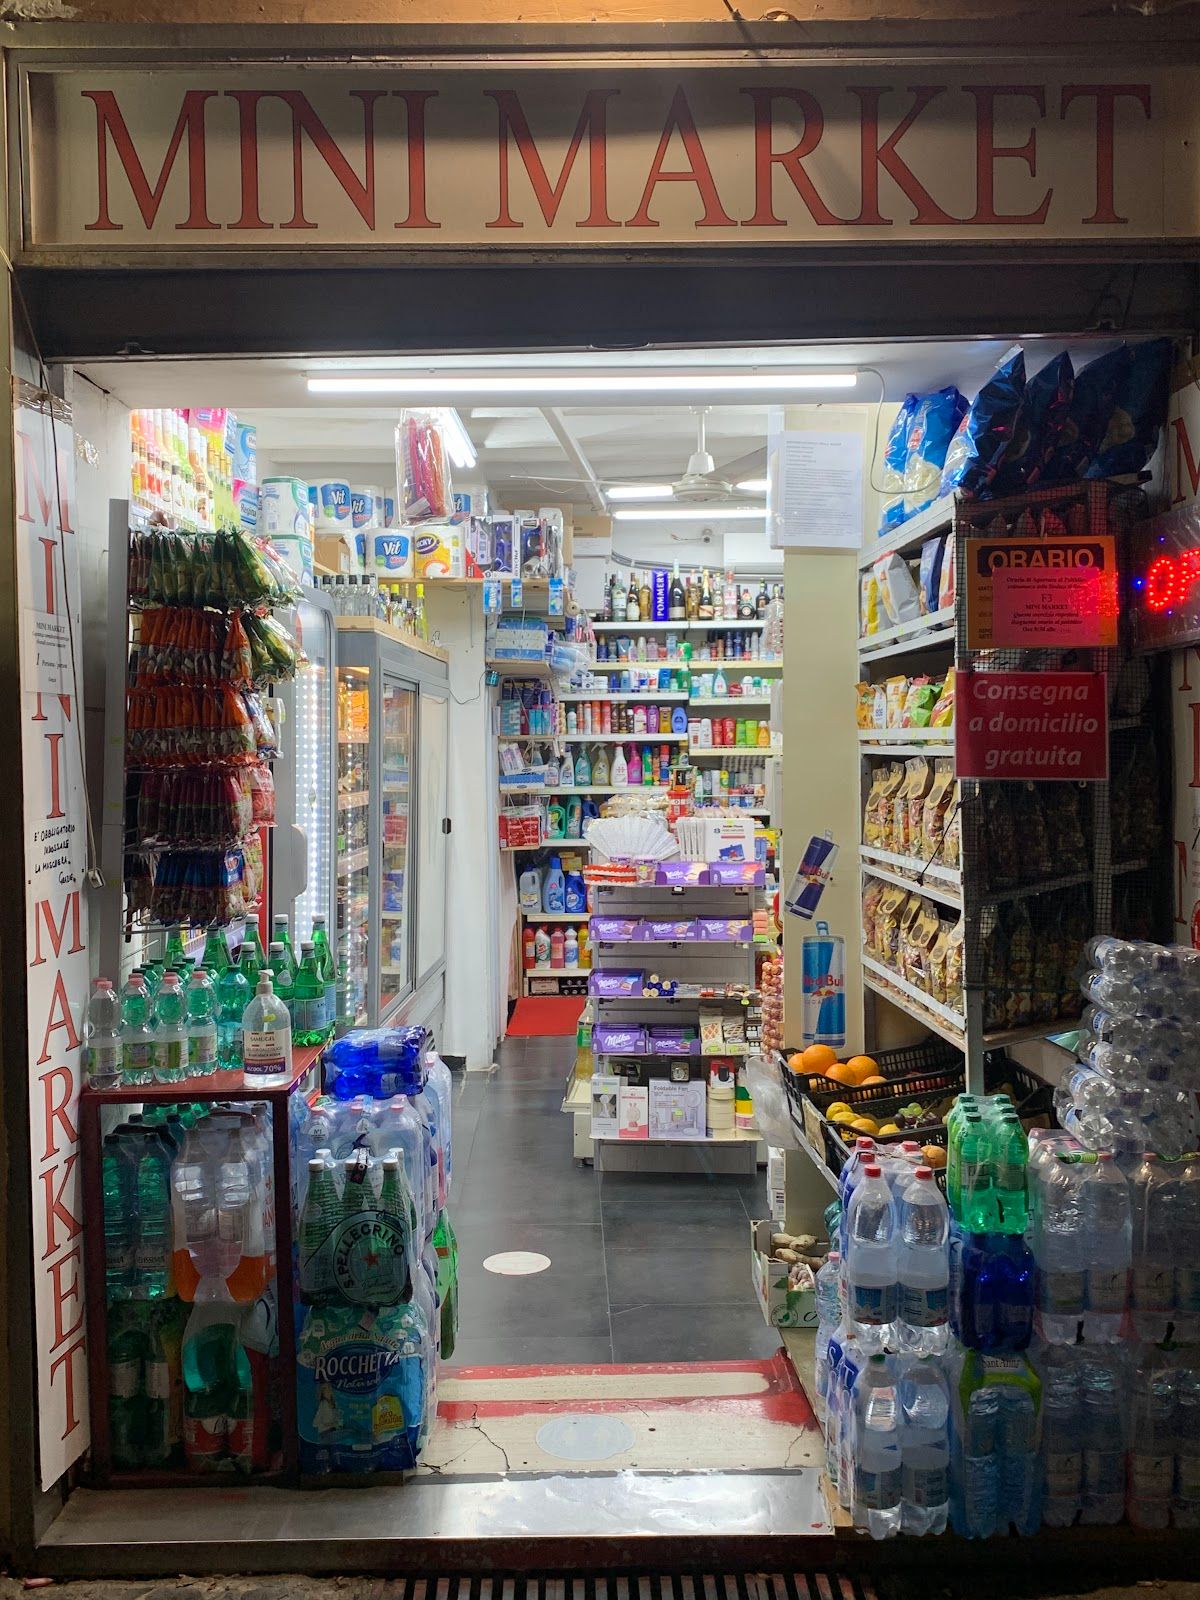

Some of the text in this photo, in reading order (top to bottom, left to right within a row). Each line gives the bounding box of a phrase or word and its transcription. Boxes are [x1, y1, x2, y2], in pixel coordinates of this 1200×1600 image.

[81, 83, 1152, 231] MINI MARKET
[383, 541, 402, 556] Vit
[988, 548, 1095, 569] ORARIO
[656, 571, 665, 616] POMMERY
[973, 680, 1089, 704] Consegna
[969, 712, 1098, 733] a domicilio
[985, 749, 1082, 769] gratuita
[605, 1035, 631, 1047] Milka
[30, 892, 86, 1440] MARKET
[315, 1351, 400, 1382] ROCCHETTA
